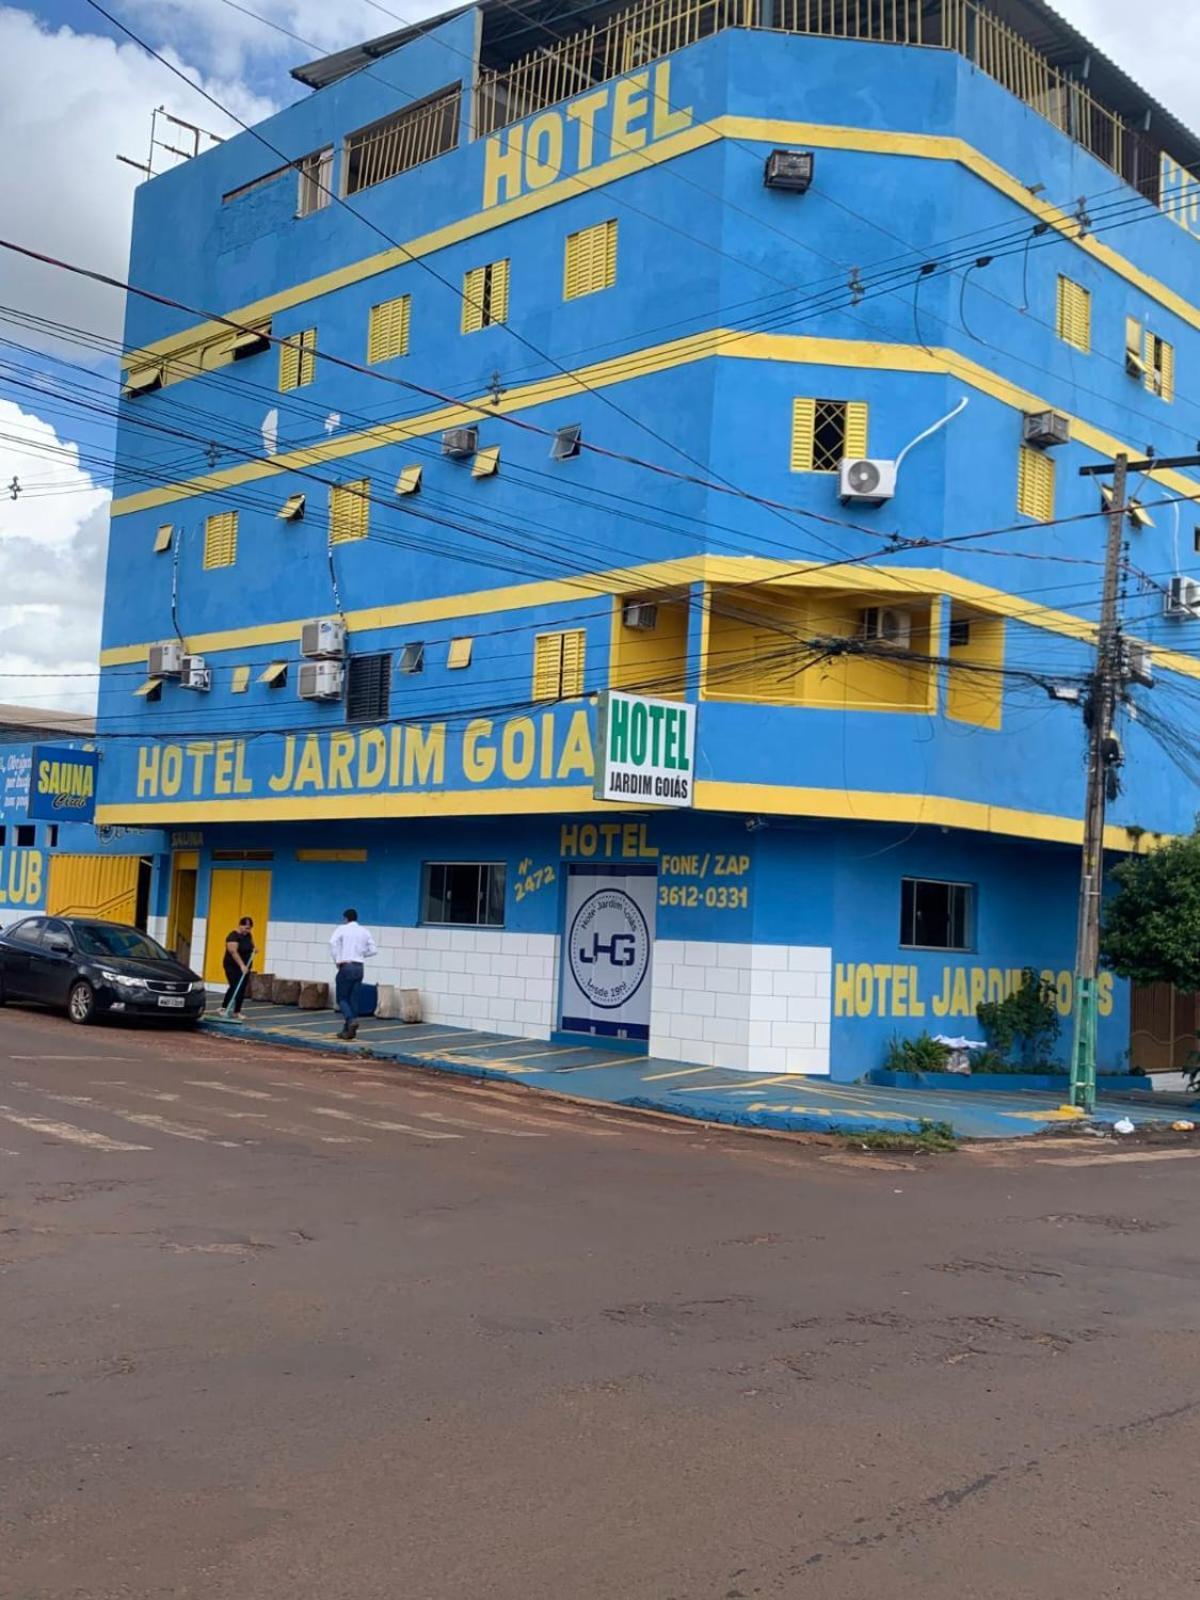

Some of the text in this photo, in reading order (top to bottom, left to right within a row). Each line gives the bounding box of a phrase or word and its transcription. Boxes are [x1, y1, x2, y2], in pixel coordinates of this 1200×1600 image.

[482, 60, 694, 210] HOTEL
[610, 698, 690, 771] HOTEL
[38, 760, 94, 798] SAUNA
[136, 738, 253, 798] HOTEL
[268, 722, 447, 793] JARDIM
[609, 771, 689, 799] JARDIM GOIÁS
[560, 823, 660, 858] HOTEL
[514, 865, 556, 902] 2472
[714, 855, 750, 876] ZAP
[834, 963, 926, 1017] HOTEL
[1040, 969, 1113, 1017] GOS
